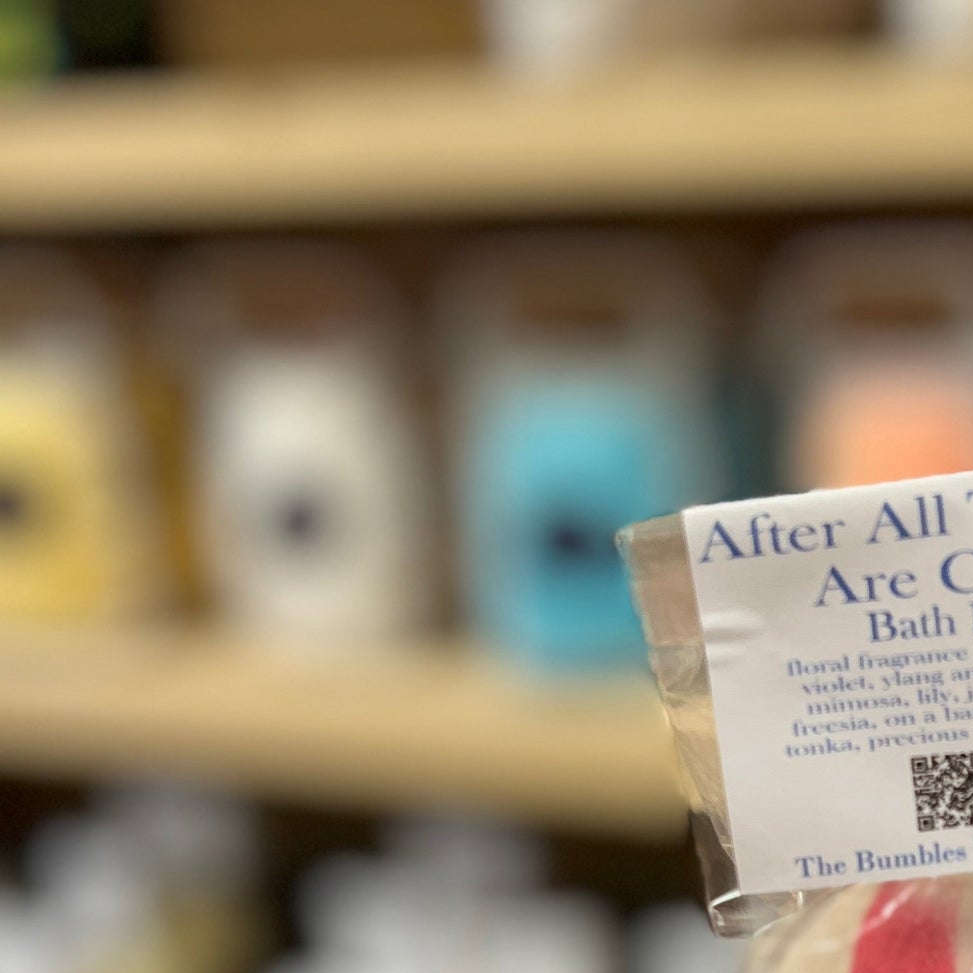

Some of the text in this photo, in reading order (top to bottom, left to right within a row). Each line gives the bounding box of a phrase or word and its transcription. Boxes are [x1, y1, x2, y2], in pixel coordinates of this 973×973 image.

[700, 512, 845, 564] After
[867, 492, 947, 544] All
[814, 566, 918, 607] Are
[868, 607, 956, 642] Bath
[787, 654, 850, 677] floral
[858, 648, 968, 668] fragrance
[802, 676, 874, 694] violet,
[881, 670, 945, 691] ylang
[807, 695, 910, 715] mimosa,
[917, 688, 958, 706] lily,
[792, 717, 877, 737] freesia,
[885, 713, 915, 727] on
[924, 712, 936, 723] a
[786, 738, 860, 757] tonka,
[868, 729, 969, 752] precious
[795, 855, 846, 878] The
[855, 843, 967, 872] Bumbles
